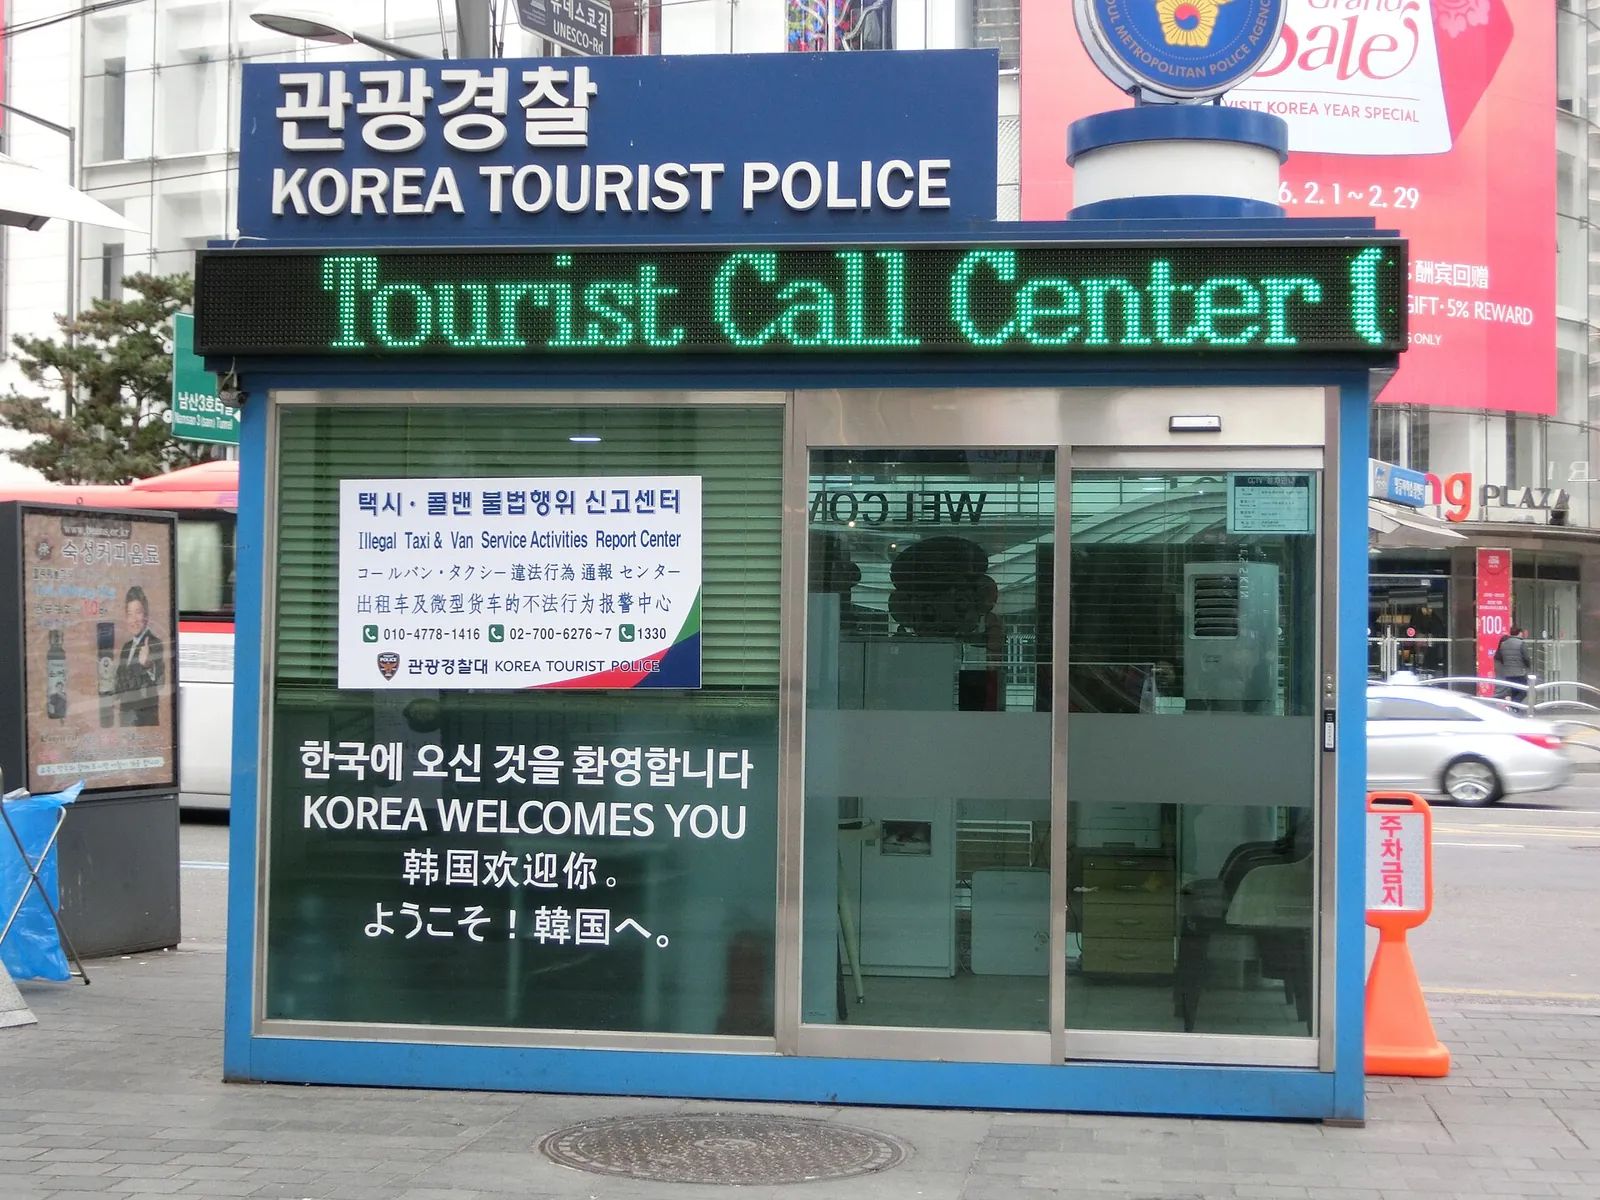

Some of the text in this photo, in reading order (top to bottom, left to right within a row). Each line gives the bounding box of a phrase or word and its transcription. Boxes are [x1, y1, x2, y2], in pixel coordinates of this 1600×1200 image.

[553, 20, 604, 55] UNESCO-Rd
[1114, 24, 1207, 79] METROPOLITAN
[1209, 43, 1250, 76] POLICE
[275, 65, 598, 152] 관광경찰
[1267, 101, 1319, 115] KOREA
[1323, 103, 1361, 118] YEAR
[1364, 106, 1420, 123] SPECIAL
[271, 158, 951, 217] KOREA TOURIST POLICE
[322, 254, 685, 347] Tourist
[713, 251, 921, 346] Call
[950, 250, 1322, 345] Center
[1474, 300, 1533, 326] REWARD
[1413, 332, 1443, 347] ONLY
[482, 489, 576, 517] 불법행위
[585, 489, 680, 515] 신고센터
[1479, 484, 1571, 511] PLAZA
[62, 540, 160, 566] 숙성커피음료
[358, 531, 397, 552] Illegal
[451, 531, 474, 549] Van
[481, 530, 527, 549] Service
[530, 530, 588, 549] Activities
[596, 530, 637, 551] Report
[640, 529, 681, 549] Center
[357, 592, 672, 615] 出租车及微型货车的不法行为报警中心
[383, 627, 667, 641] 010-4778-1416 02-700-6276~7 1330
[1481, 615, 1502, 635] 100
[408, 658, 661, 676] 관광경찰대 KOREA TOURIST POLICE
[299, 740, 755, 790] 한국에 오신 것을 환영합니다
[303, 794, 747, 840] KOREA WELCOMES YOU
[402, 847, 617, 890] 韩国欢迎你。
[1379, 815, 1405, 908] 주차금지
